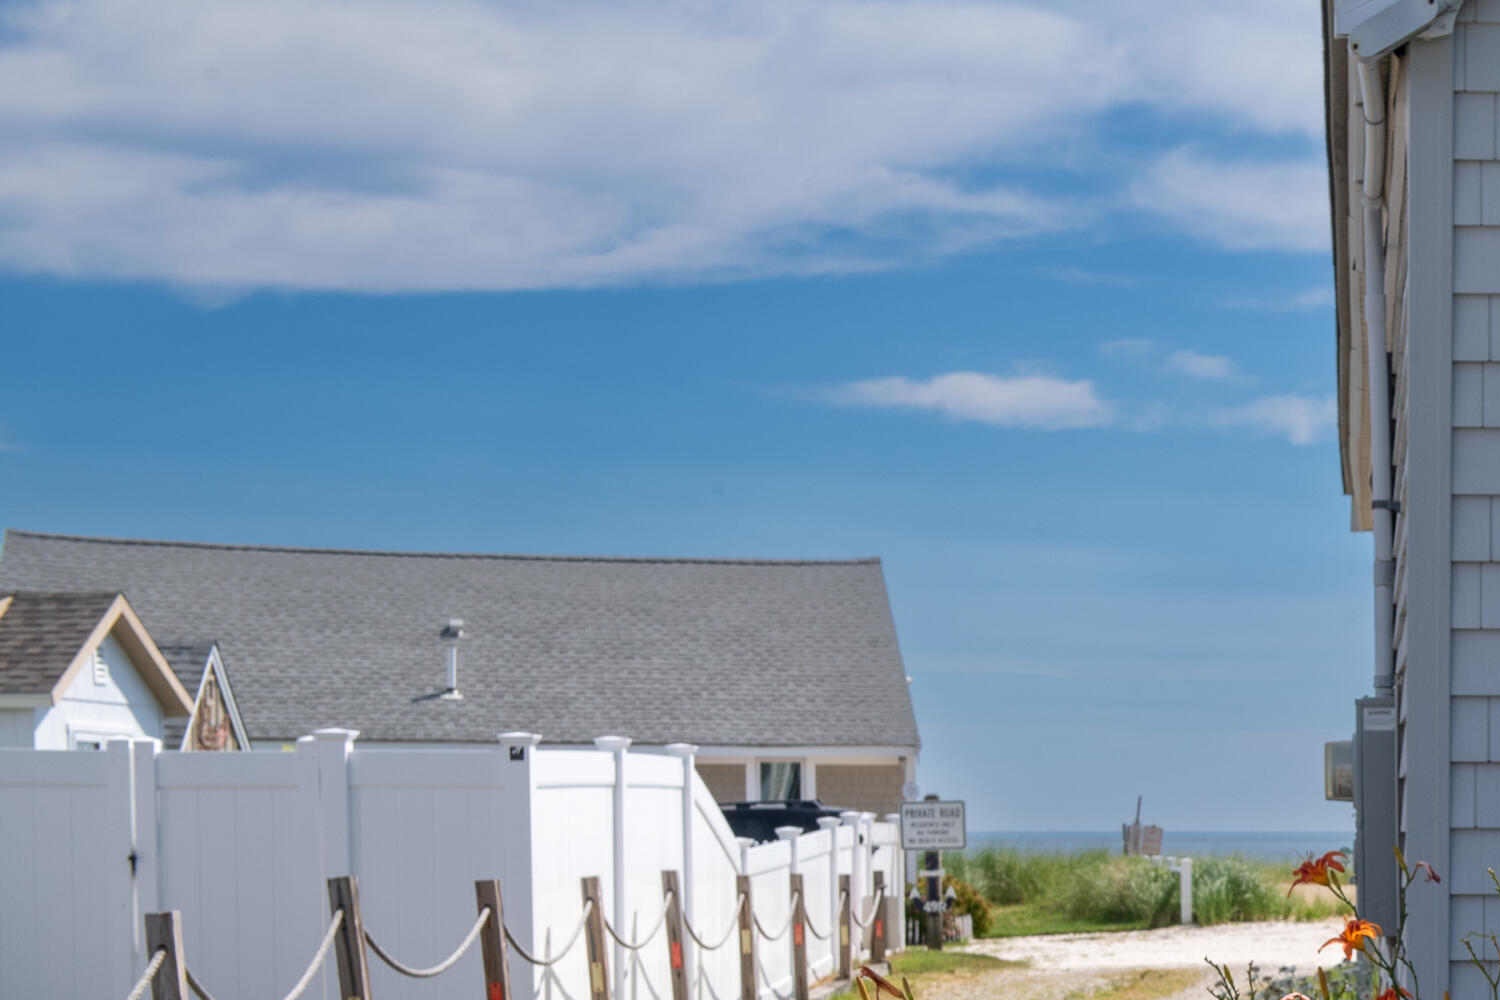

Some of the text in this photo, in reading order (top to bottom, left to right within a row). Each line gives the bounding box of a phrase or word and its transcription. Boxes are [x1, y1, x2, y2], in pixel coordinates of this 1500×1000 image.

[904, 808, 961, 819] PRIVATE ROAD
[923, 900, 947, 912] 49R
